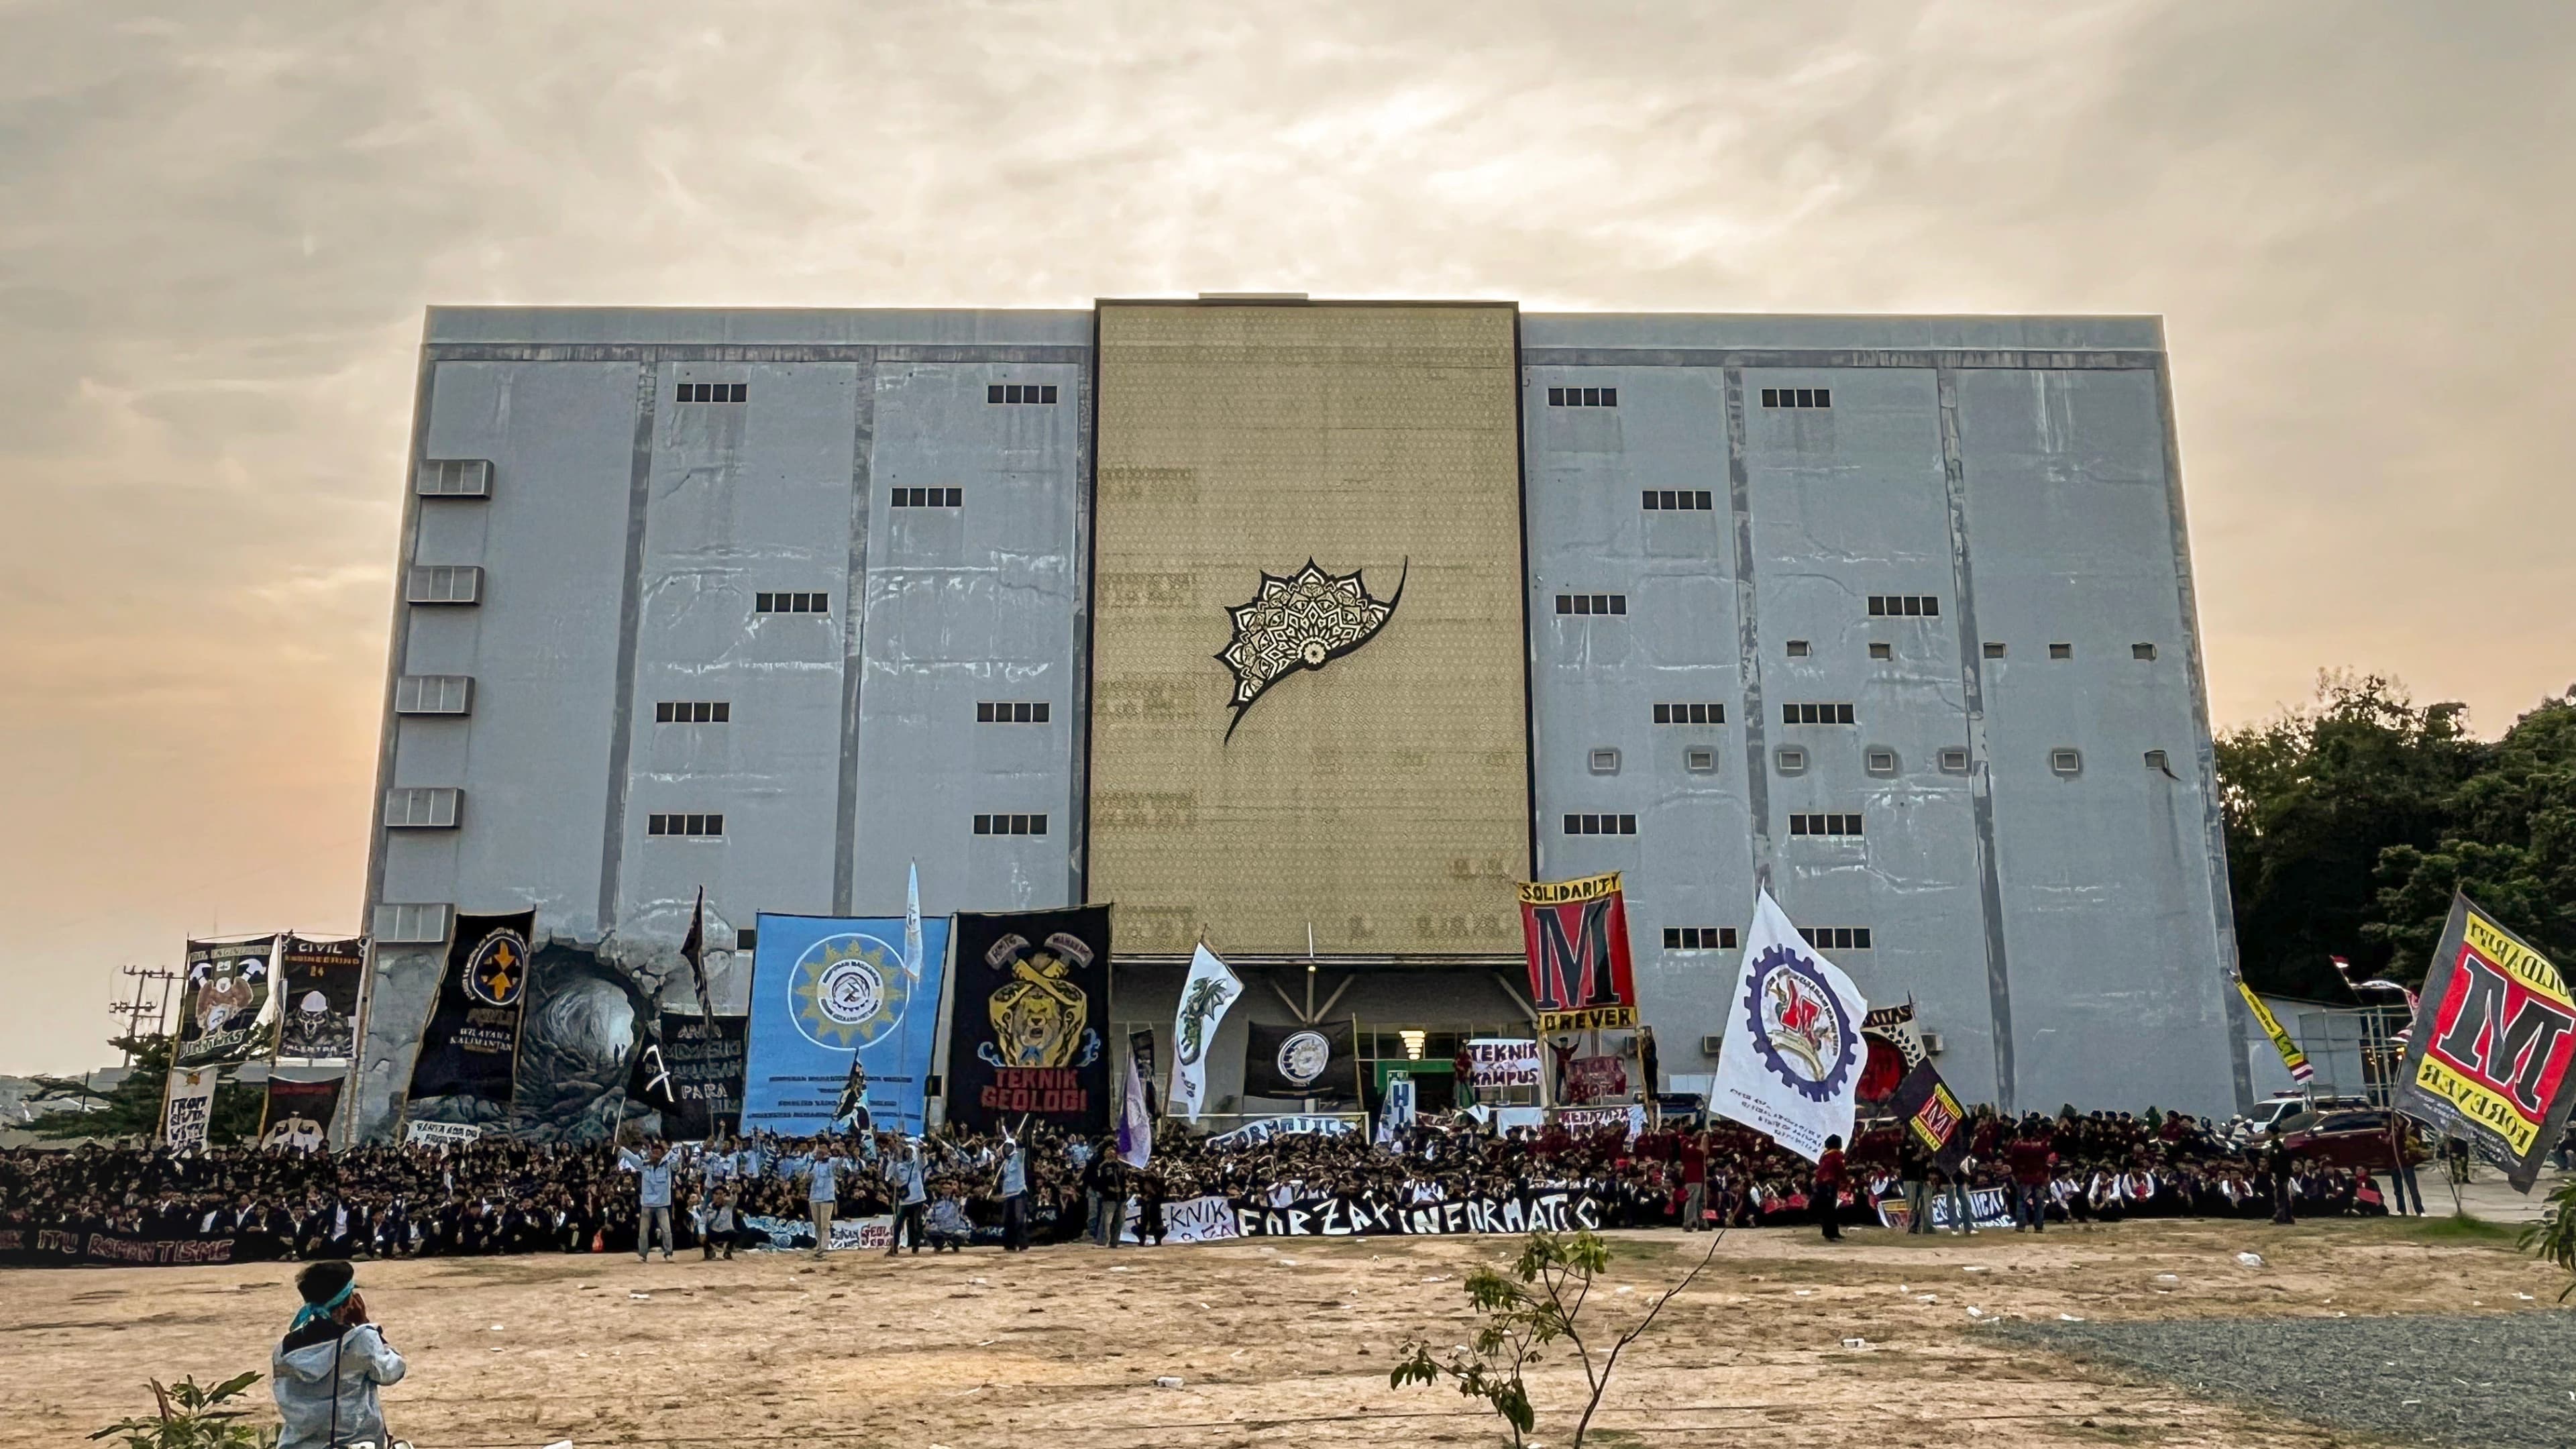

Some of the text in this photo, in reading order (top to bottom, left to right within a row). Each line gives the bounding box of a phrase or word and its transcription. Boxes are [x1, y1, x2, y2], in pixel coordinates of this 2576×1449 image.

[1521, 875, 1618, 902] SOLIDARITY
[299, 943, 343, 955] CIVIL
[1532, 897, 1621, 1010] M
[450, 1036, 513, 1052] KALIMANTAN
[1467, 1042, 1538, 1062] TEKNIK
[995, 1069, 1079, 1089] TEKNIK
[1470, 1068, 1538, 1087] KAMPUS
[682, 1082, 727, 1099] PARA
[980, 1085, 1088, 1111] GEOLOGI
[1125, 1199, 1228, 1232] TKNIK
[1236, 1197, 1373, 1236] FORZA
[1397, 1193, 1599, 1234] INFORMATIC
[37, 1230, 78, 1254] ITU
